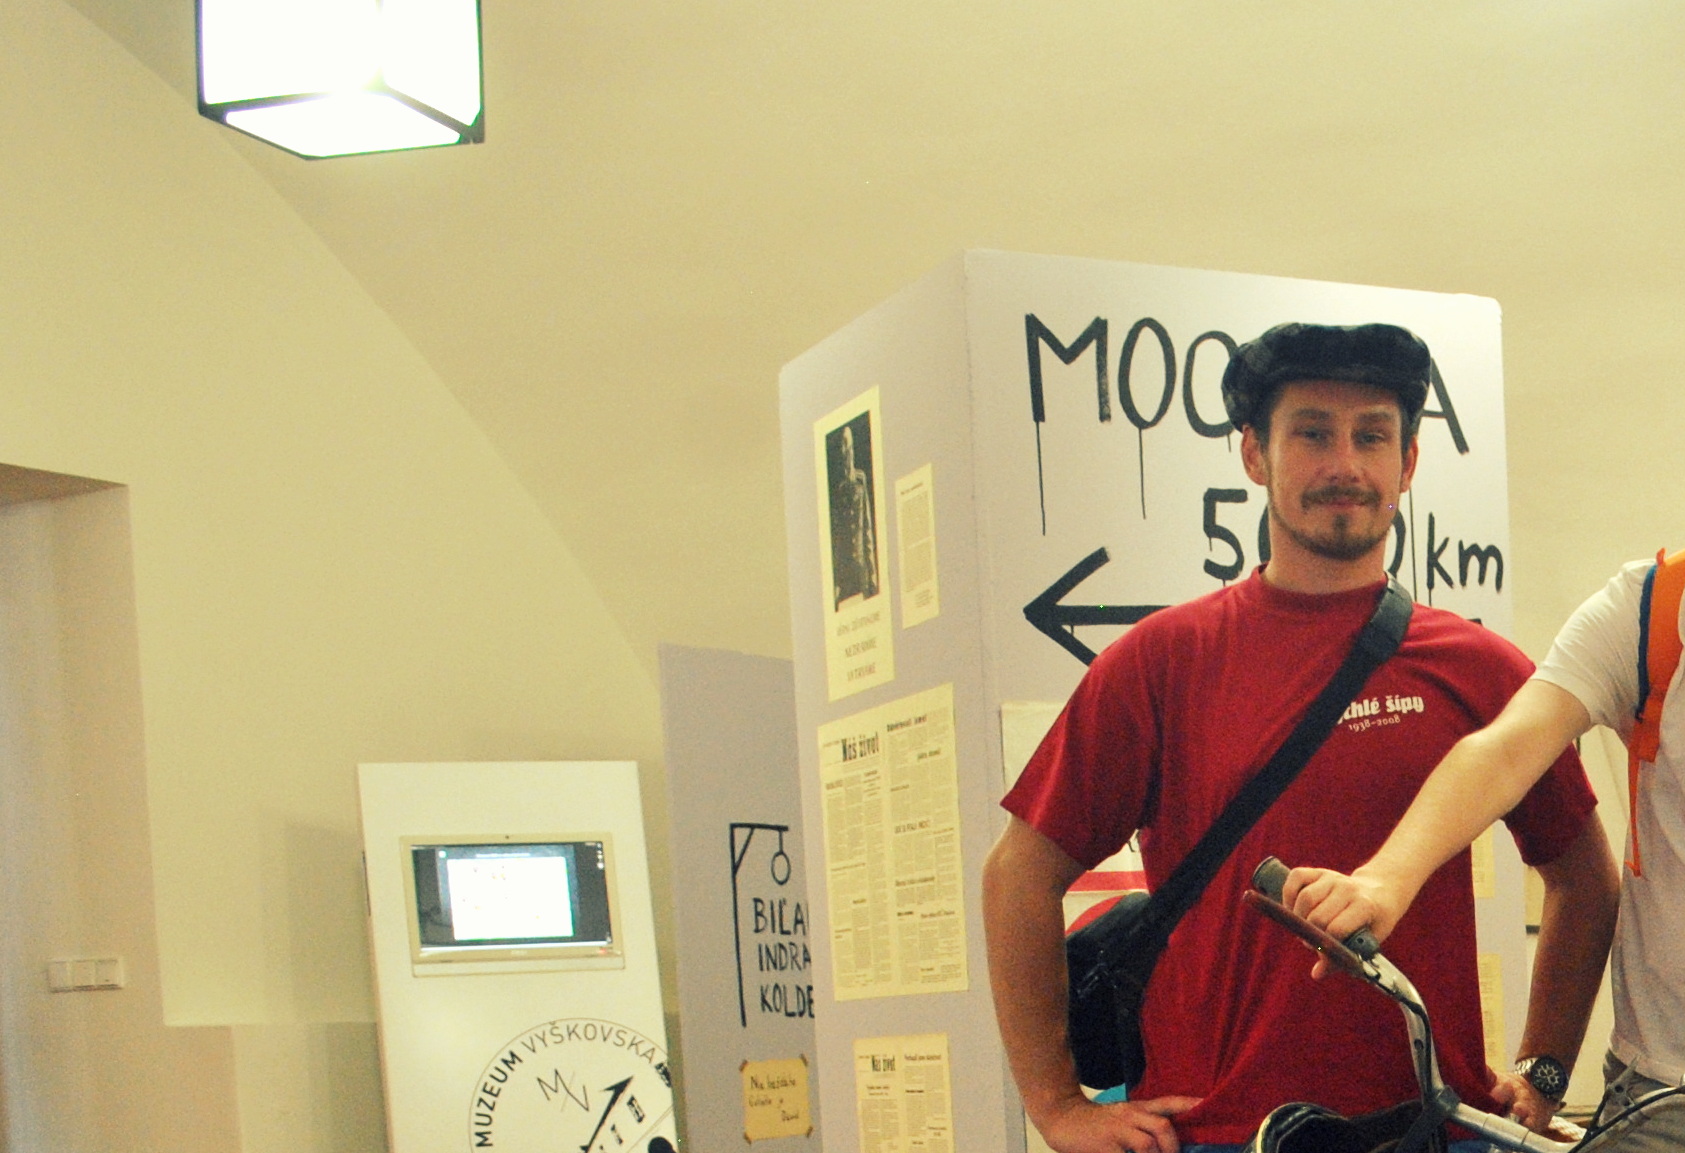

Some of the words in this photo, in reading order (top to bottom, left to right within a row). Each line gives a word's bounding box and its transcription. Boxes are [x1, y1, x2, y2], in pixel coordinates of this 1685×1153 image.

[1337, 697, 1380, 725] chlé
[1348, 713, 1401, 733] 1938-2008
[474, 1050, 524, 1148] MUZEUM
[521, 1020, 656, 1066] VYŠKOVSKA
